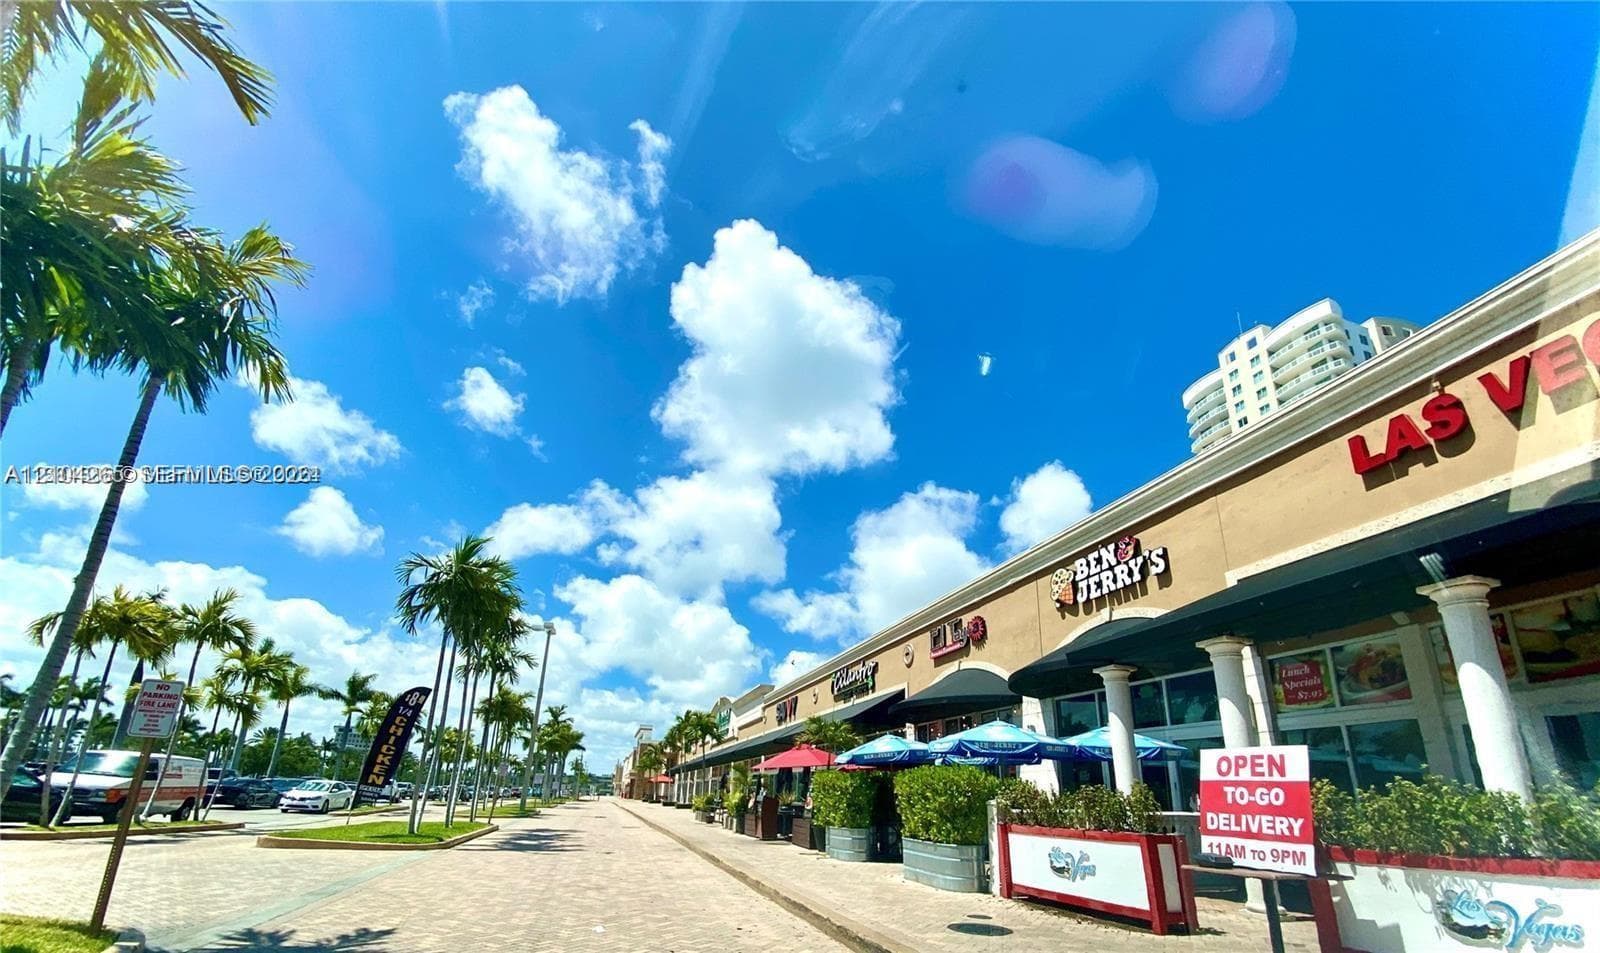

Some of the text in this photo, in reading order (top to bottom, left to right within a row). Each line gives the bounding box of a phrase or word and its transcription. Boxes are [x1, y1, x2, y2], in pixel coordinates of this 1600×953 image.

[1348, 393, 1467, 475] LAS
[1075, 535, 1137, 581] BEN &
[1076, 546, 1166, 604] JERRY'S
[834, 661, 876, 690] Cilantro
[1281, 664, 1310, 678] Lunch
[1284, 676, 1321, 690] Specials
[140, 700, 177, 709] FIRE LANE
[143, 691, 179, 700] PARKING
[368, 716, 408, 785] CHICKEN
[1216, 753, 1287, 777] OPEN
[1222, 786, 1285, 806] TO-GO
[1206, 812, 1305, 837] DELIVERY
[1207, 841, 1306, 866] 11AM TO 9PM
[1485, 898, 1584, 949] Vegas
